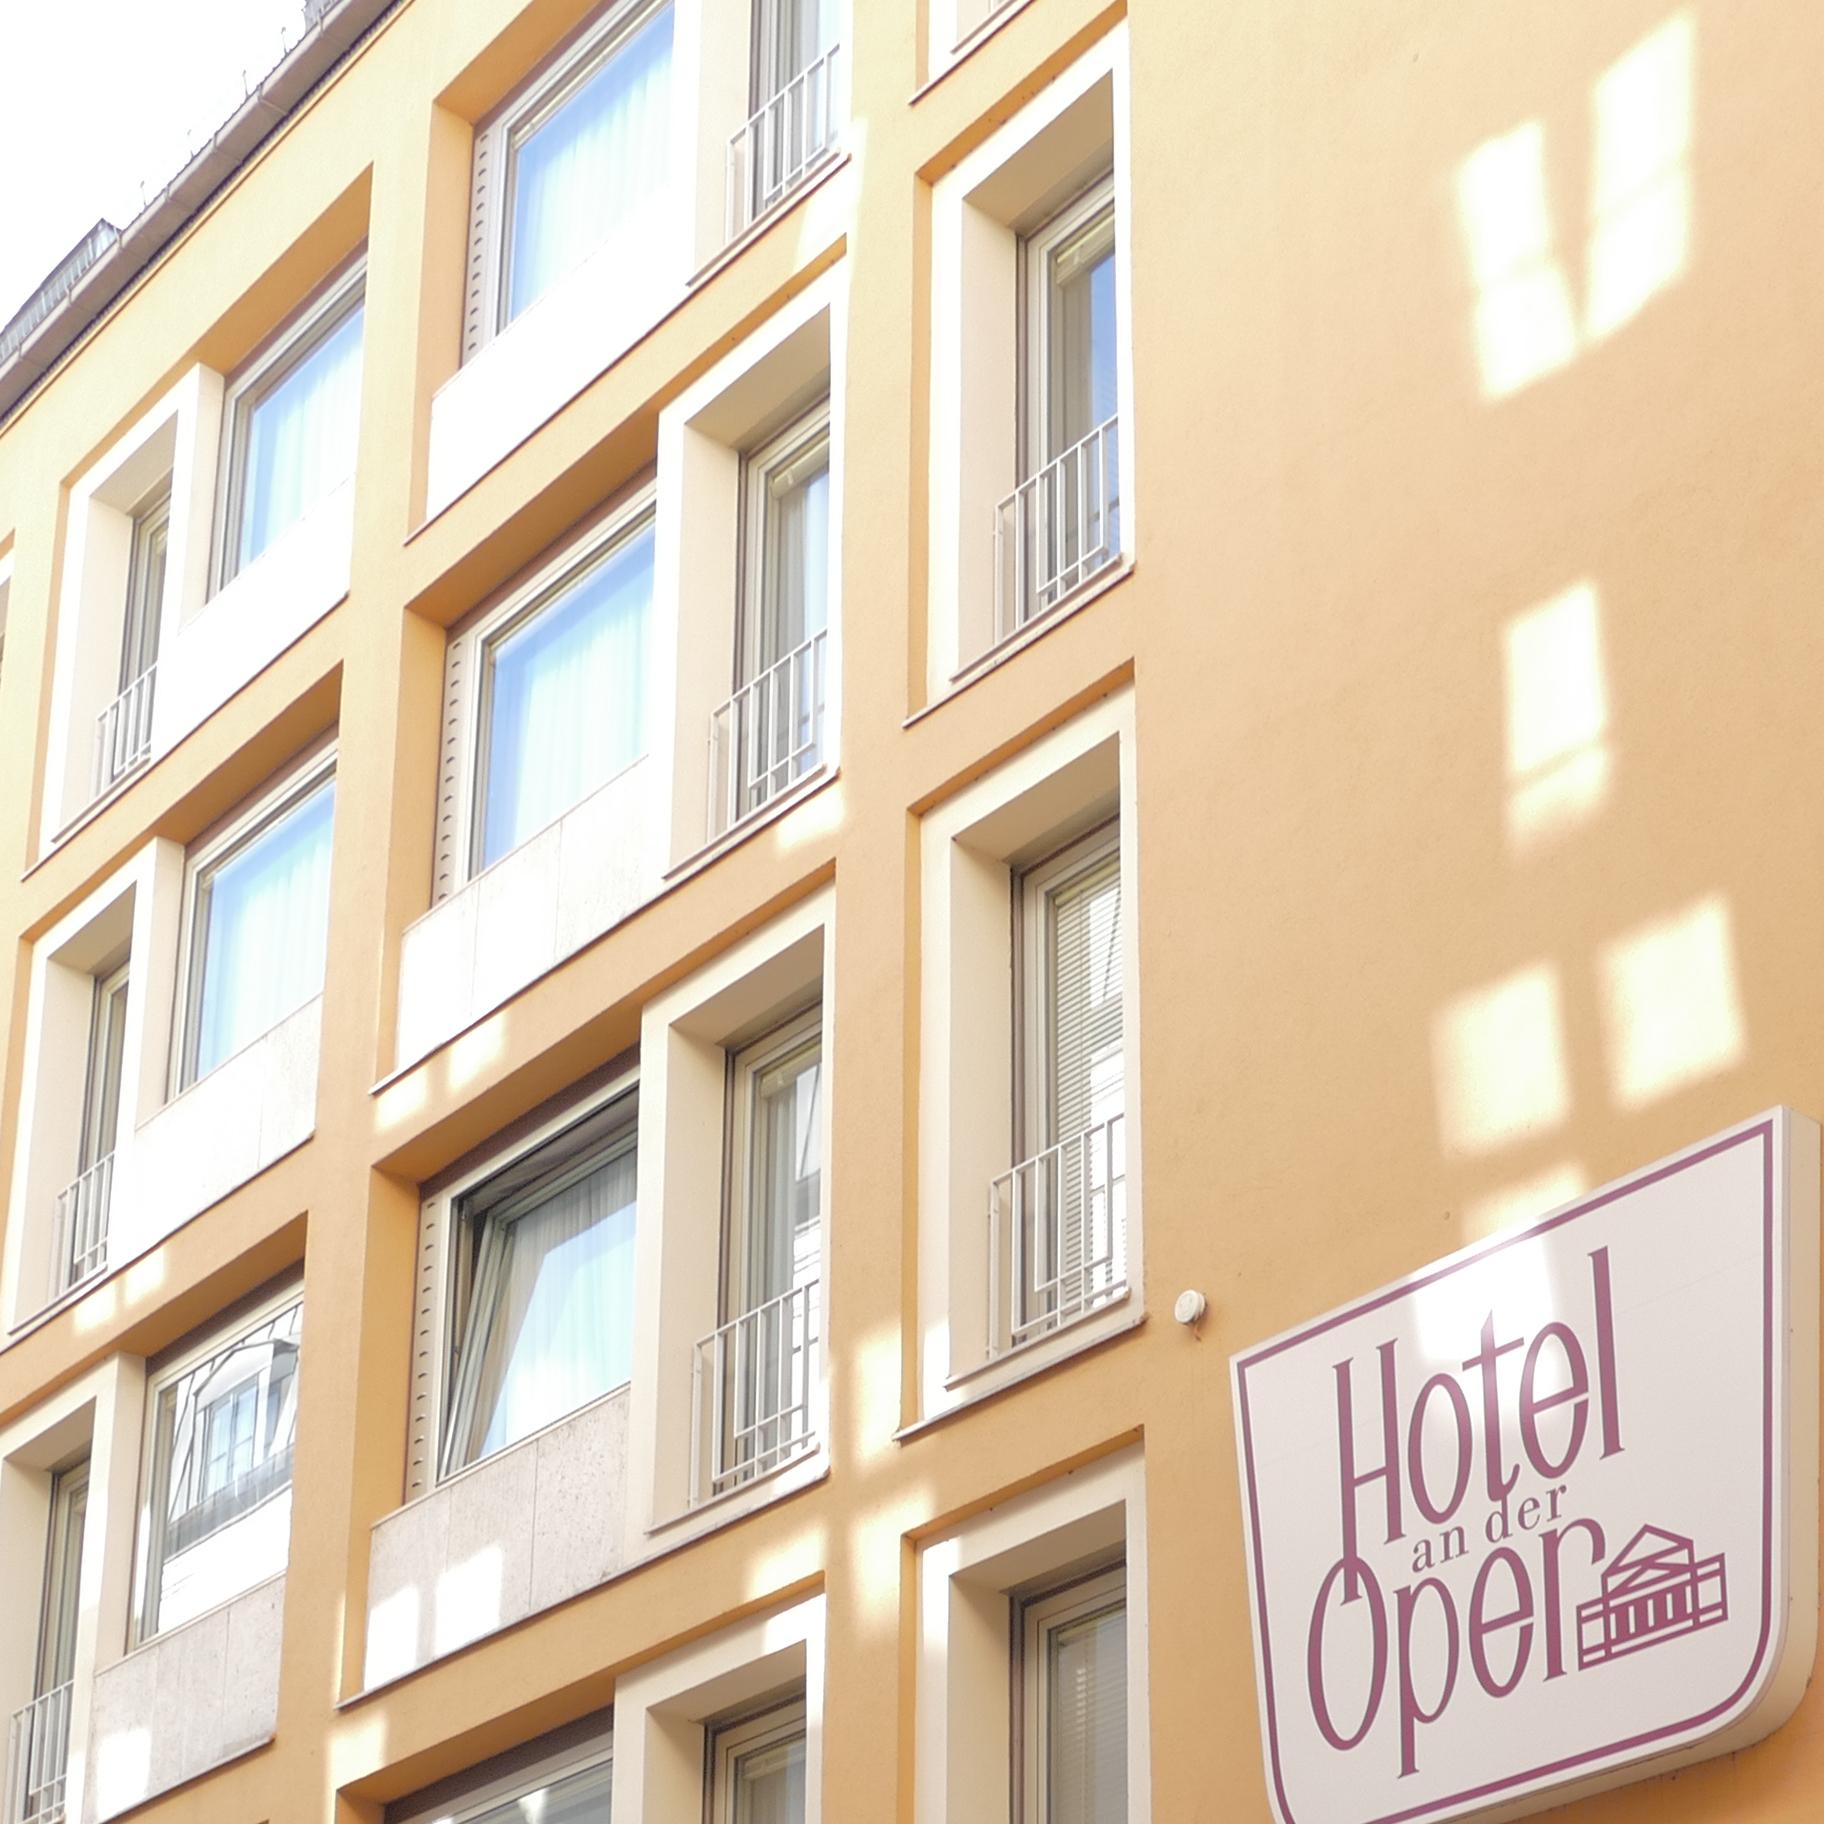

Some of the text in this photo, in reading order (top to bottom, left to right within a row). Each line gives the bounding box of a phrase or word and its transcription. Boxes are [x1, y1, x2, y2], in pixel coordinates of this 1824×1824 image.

[1332, 1245, 1625, 1606] Hotel
[1411, 1484, 1567, 1574] an der
[1307, 1517, 1606, 1779] Oper
